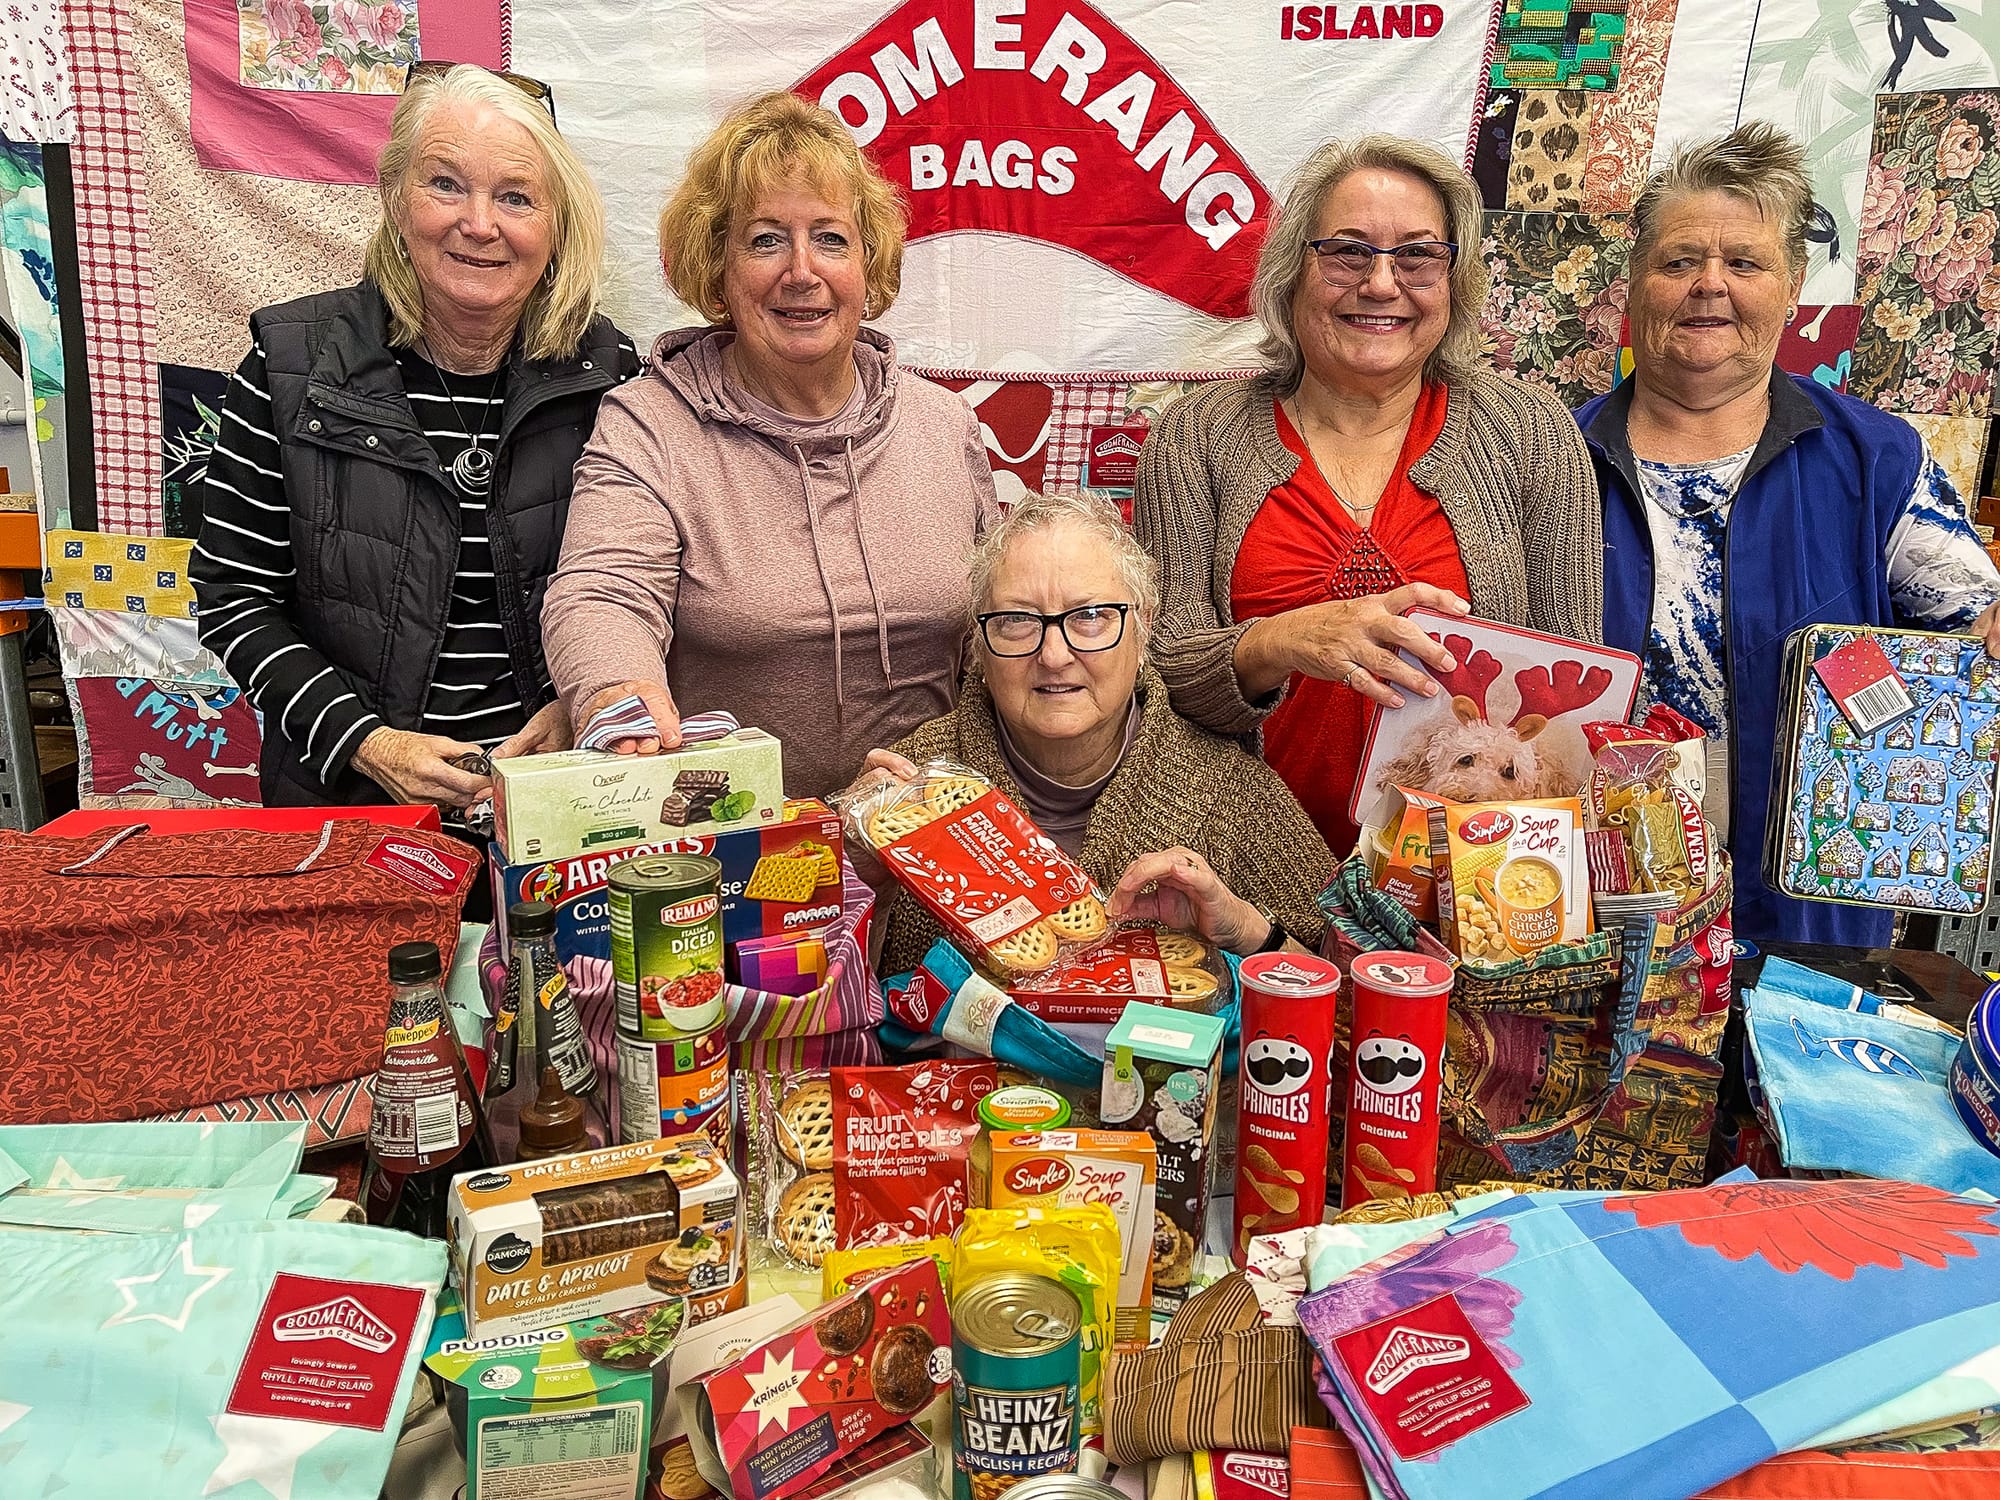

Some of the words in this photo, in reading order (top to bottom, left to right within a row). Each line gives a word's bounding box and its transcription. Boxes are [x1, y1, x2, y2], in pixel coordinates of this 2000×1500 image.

[1280, 4, 1443, 40] ISLAND
[818, 0, 1256, 251] OMERANG
[909, 139, 1077, 196] BAGS
[134, 690, 228, 759] Mutt
[971, 810, 1014, 849] FRUIT
[1466, 814, 1511, 842] Simplee
[1520, 816, 1559, 835] Soup
[1674, 787, 1707, 876] REMANO
[961, 815, 1008, 861] MINCE
[1002, 859, 1037, 888] PIES
[1527, 833, 1559, 854] Cup
[664, 897, 717, 922] REMANO
[1511, 911, 1543, 922] CORN
[1546, 909, 1553, 917] &
[576, 926, 599, 935] WITH
[681, 924, 709, 937] ITALIAN
[1509, 915, 1557, 932] CHICKEN
[1510, 925, 1558, 941] FLAVOURED
[672, 930, 715, 954] DICED
[1049, 1005, 1084, 1014] FRUIT
[386, 1024, 434, 1047] Schweppes
[1243, 1080, 1310, 1124] PRINGLES
[1354, 1079, 1422, 1123] PRINGLES
[1962, 1077, 1994, 1129] Queen's
[847, 1114, 906, 1135] FRUIT
[1250, 1123, 1296, 1140] ORIGINAL
[1360, 1122, 1408, 1139] ORIGINAL
[847, 1132, 915, 1152] MINCE
[918, 1128, 963, 1148] PIES
[523, 1162, 563, 1180] DATE
[570, 1159, 582, 1170] &
[589, 1143, 655, 1166] APRICOT
[897, 1155, 927, 1167] pastry
[928, 1152, 950, 1162] with
[1156, 1153, 1182, 1168] ALT
[468, 1175, 511, 1189] DAMORA
[848, 1168, 868, 1178] fruit
[899, 1166, 927, 1177] filling
[1012, 1162, 1066, 1193] Simplee
[1075, 1166, 1126, 1189] Soup
[1083, 1186, 1123, 1206] Cup
[487, 1248, 531, 1262] DAMORA
[486, 1279, 534, 1305] DATE
[537, 1273, 554, 1293] &
[558, 1252, 633, 1287] APRICOT
[514, 1291, 557, 1309] SPECIALTY
[558, 1283, 597, 1299] CRACKERS
[691, 1295, 729, 1317] ABY
[286, 1304, 385, 1340] BOOMERANG
[318, 1329, 351, 1339] BAGS
[446, 1330, 564, 1353] PUDDING
[290, 1357, 324, 1368] lovingly
[326, 1361, 347, 1370] sewn
[348, 1362, 357, 1371] in
[1373, 1333, 1457, 1381] BOOMERANG
[1402, 1357, 1431, 1373] BAGS
[261, 1371, 296, 1384] RHYLL,
[298, 1375, 336, 1389] PHILLIP
[337, 1380, 374, 1392] ISLAND
[753, 1375, 799, 1407] KRINGLE
[270, 1393, 352, 1410] boomerangbags.org
[977, 1396, 1058, 1423] HEINZ
[1397, 1411, 1429, 1428] RHYLL,
[1427, 1394, 1459, 1412] PHILLIP
[1460, 1380, 1492, 1398] ISLAND
[508, 1416, 544, 1426] NUTRITION
[546, 1412, 591, 1422] INFORMATION
[749, 1433, 804, 1469] TRADITIONAL
[805, 1416, 829, 1434] FRUIT
[966, 1417, 1069, 1455] BEANZ
[760, 1457, 779, 1472] MINI
[781, 1430, 822, 1459] PUDDINGS
[965, 1450, 1023, 1471] ENGLISH
[1027, 1450, 1070, 1470] RECIPE
[1234, 1464, 1289, 1492] ERANG
